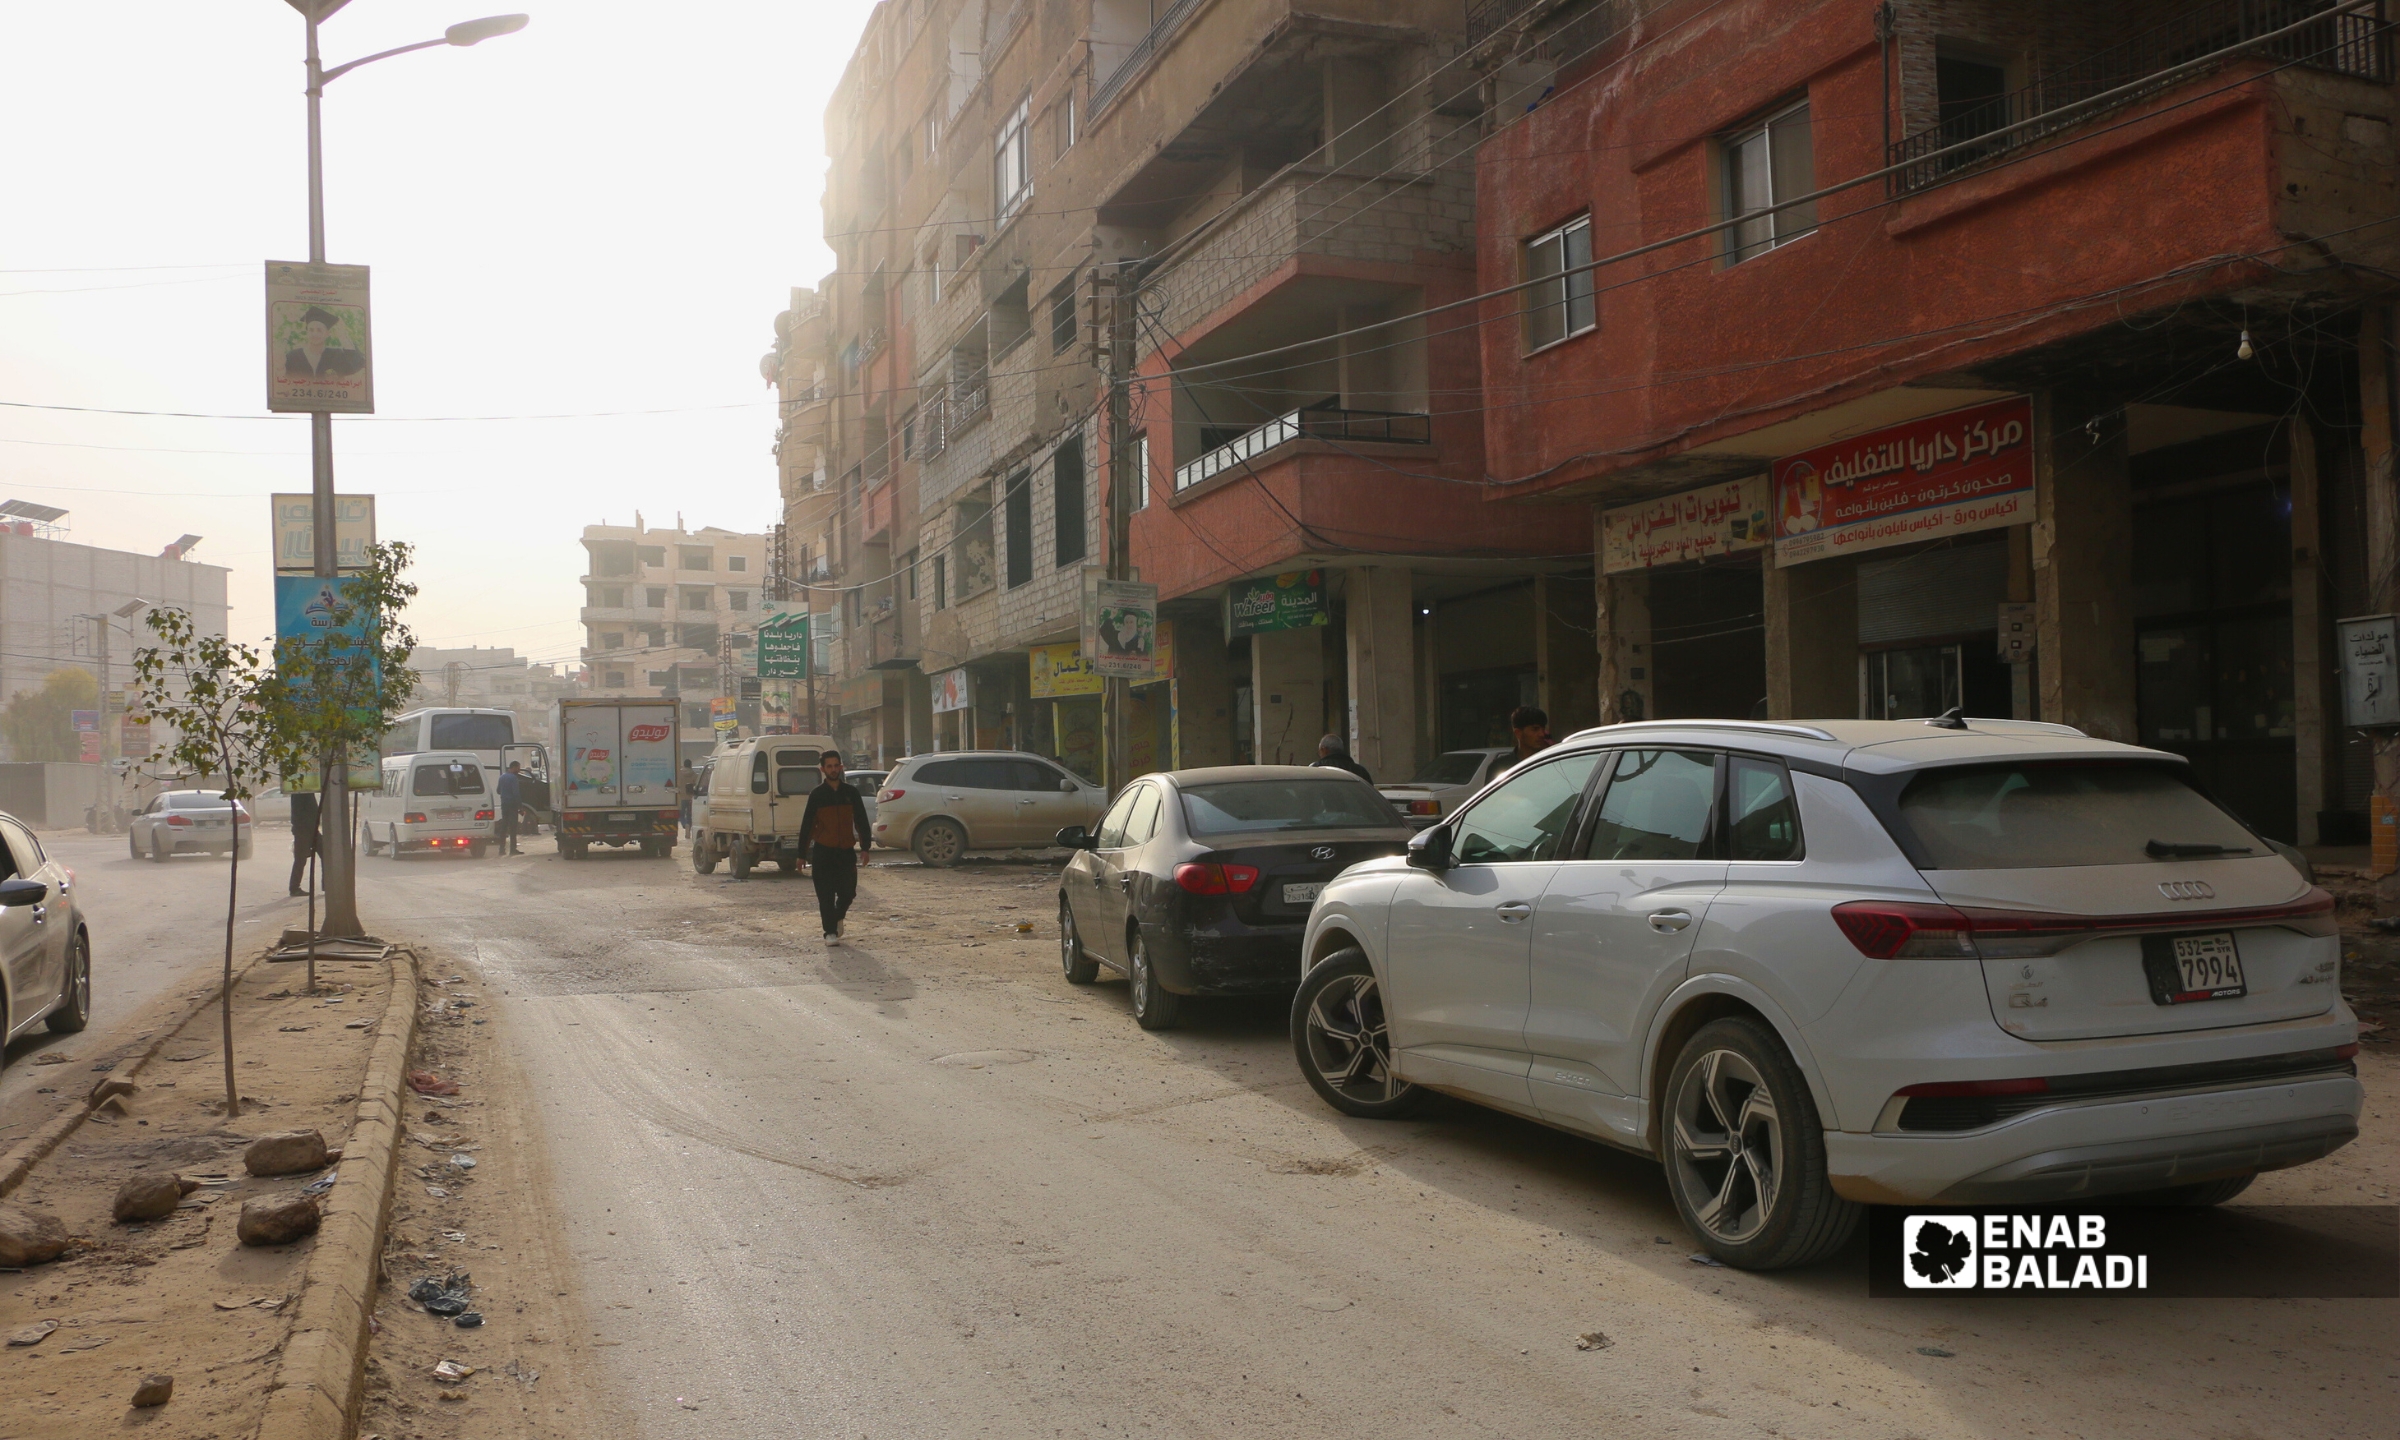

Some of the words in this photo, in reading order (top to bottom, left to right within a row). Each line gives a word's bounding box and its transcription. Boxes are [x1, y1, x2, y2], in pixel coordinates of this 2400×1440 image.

[291, 388, 348, 399] 234.6/240
[1962, 419, 2024, 462] مركز
[1908, 430, 1958, 472] داريا
[1823, 439, 1905, 487] للتغليف
[1917, 481, 1961, 502] كرتون
[1962, 472, 2012, 493] صحون
[1835, 495, 1879, 518] بأنواعه
[1879, 490, 1910, 511] فلين
[1978, 495, 2018, 520] أكياس
[1627, 499, 1681, 542] الفراس
[1909, 510, 1943, 533] أكياس
[1952, 508, 1977, 526] ورق
[1833, 523, 1876, 546] بأنواعها
[1877, 519, 1908, 539] نايلون
[1233, 598, 1276, 618] Wafeer
[1281, 591, 1318, 608] المدينة
[763, 630, 783, 639] بلدنا
[784, 631, 803, 641] داريا
[764, 642, 801, 653] فاجعلوها
[1053, 659, 1081, 678] كمال
[631, 727, 668, 740] توليدو
[2176, 939, 2203, 957] 532
[2216, 946, 2232, 954] SYR
[2181, 955, 2238, 988] 7994
[2211, 988, 2241, 998] MOTORS
